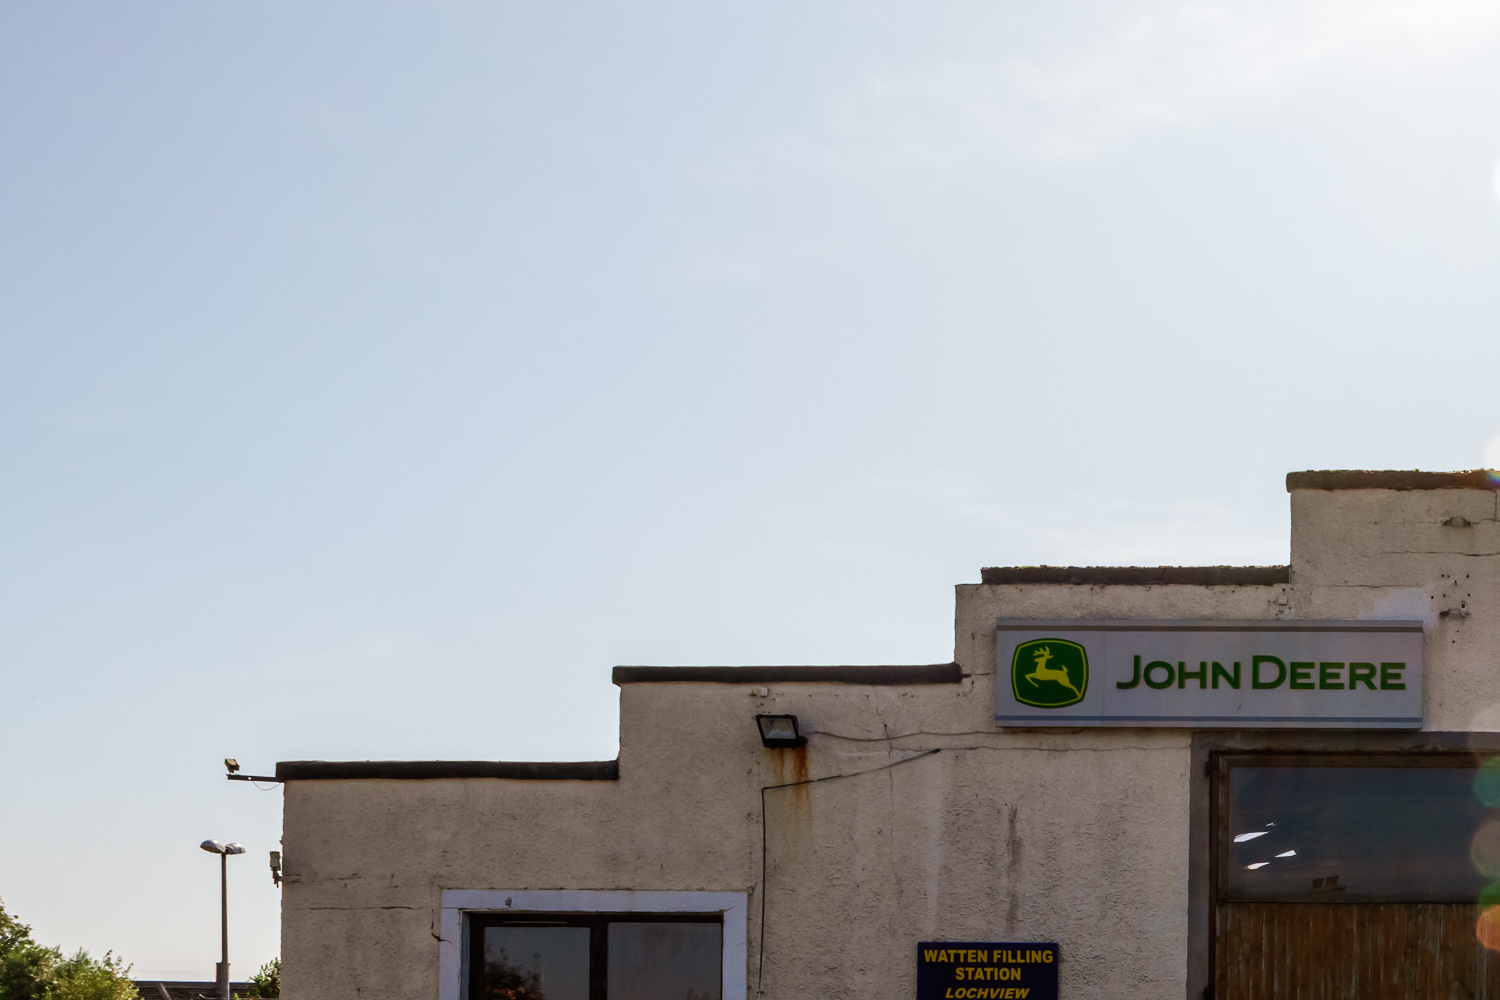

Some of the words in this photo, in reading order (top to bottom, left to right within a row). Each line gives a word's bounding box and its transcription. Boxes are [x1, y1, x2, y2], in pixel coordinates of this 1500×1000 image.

[1116, 655, 1240, 689] JOHN
[1252, 655, 1405, 690] DEERE
[924, 950, 987, 962] WATTEN
[994, 950, 1053, 963] FILLING
[956, 967, 1021, 980] STATION
[945, 988, 1029, 999] LOCHVIEW
